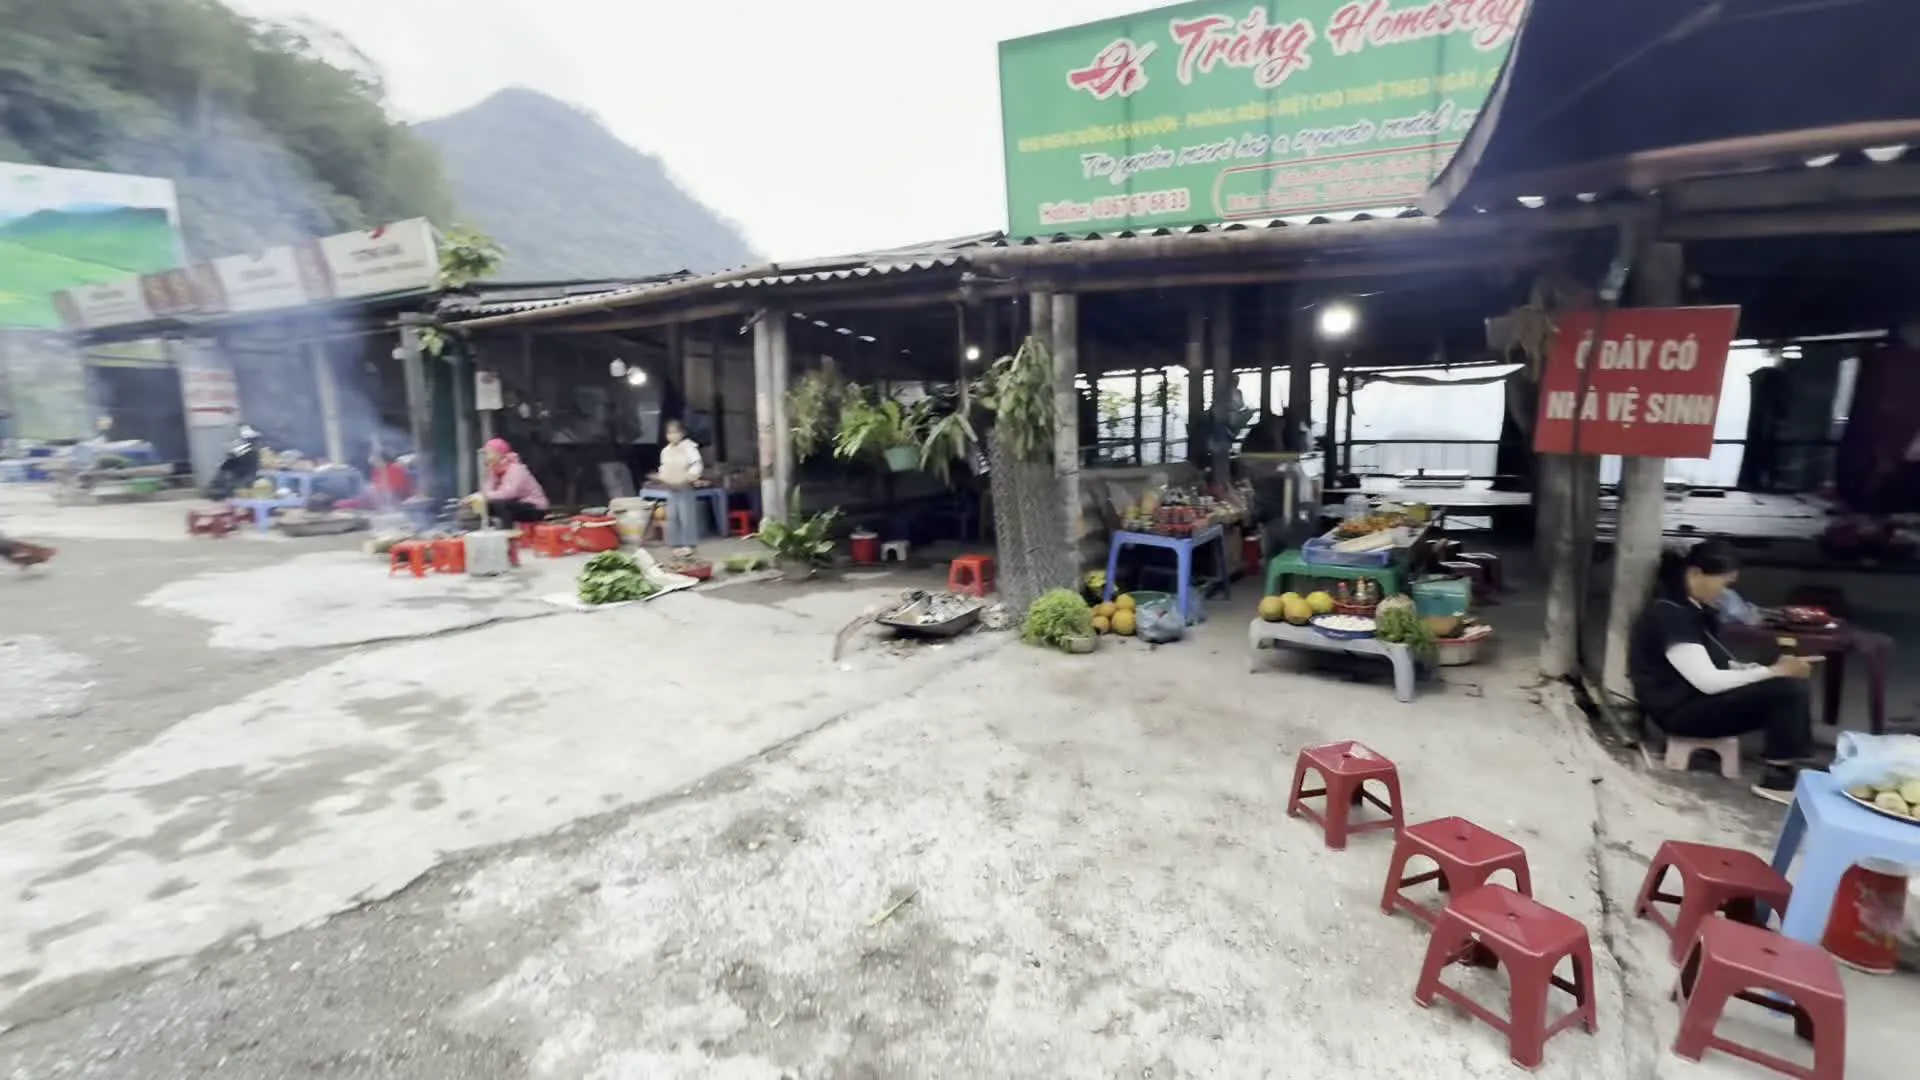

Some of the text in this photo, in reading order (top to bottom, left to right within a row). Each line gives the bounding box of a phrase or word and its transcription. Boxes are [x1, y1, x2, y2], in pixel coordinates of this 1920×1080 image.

[1171, 9, 1307, 85] Trắng
[1328, 0, 1522, 50] Homestay
[1659, 333, 1698, 371] CÓ
[1547, 385, 1714, 428] NHÀ VỆ SINH
